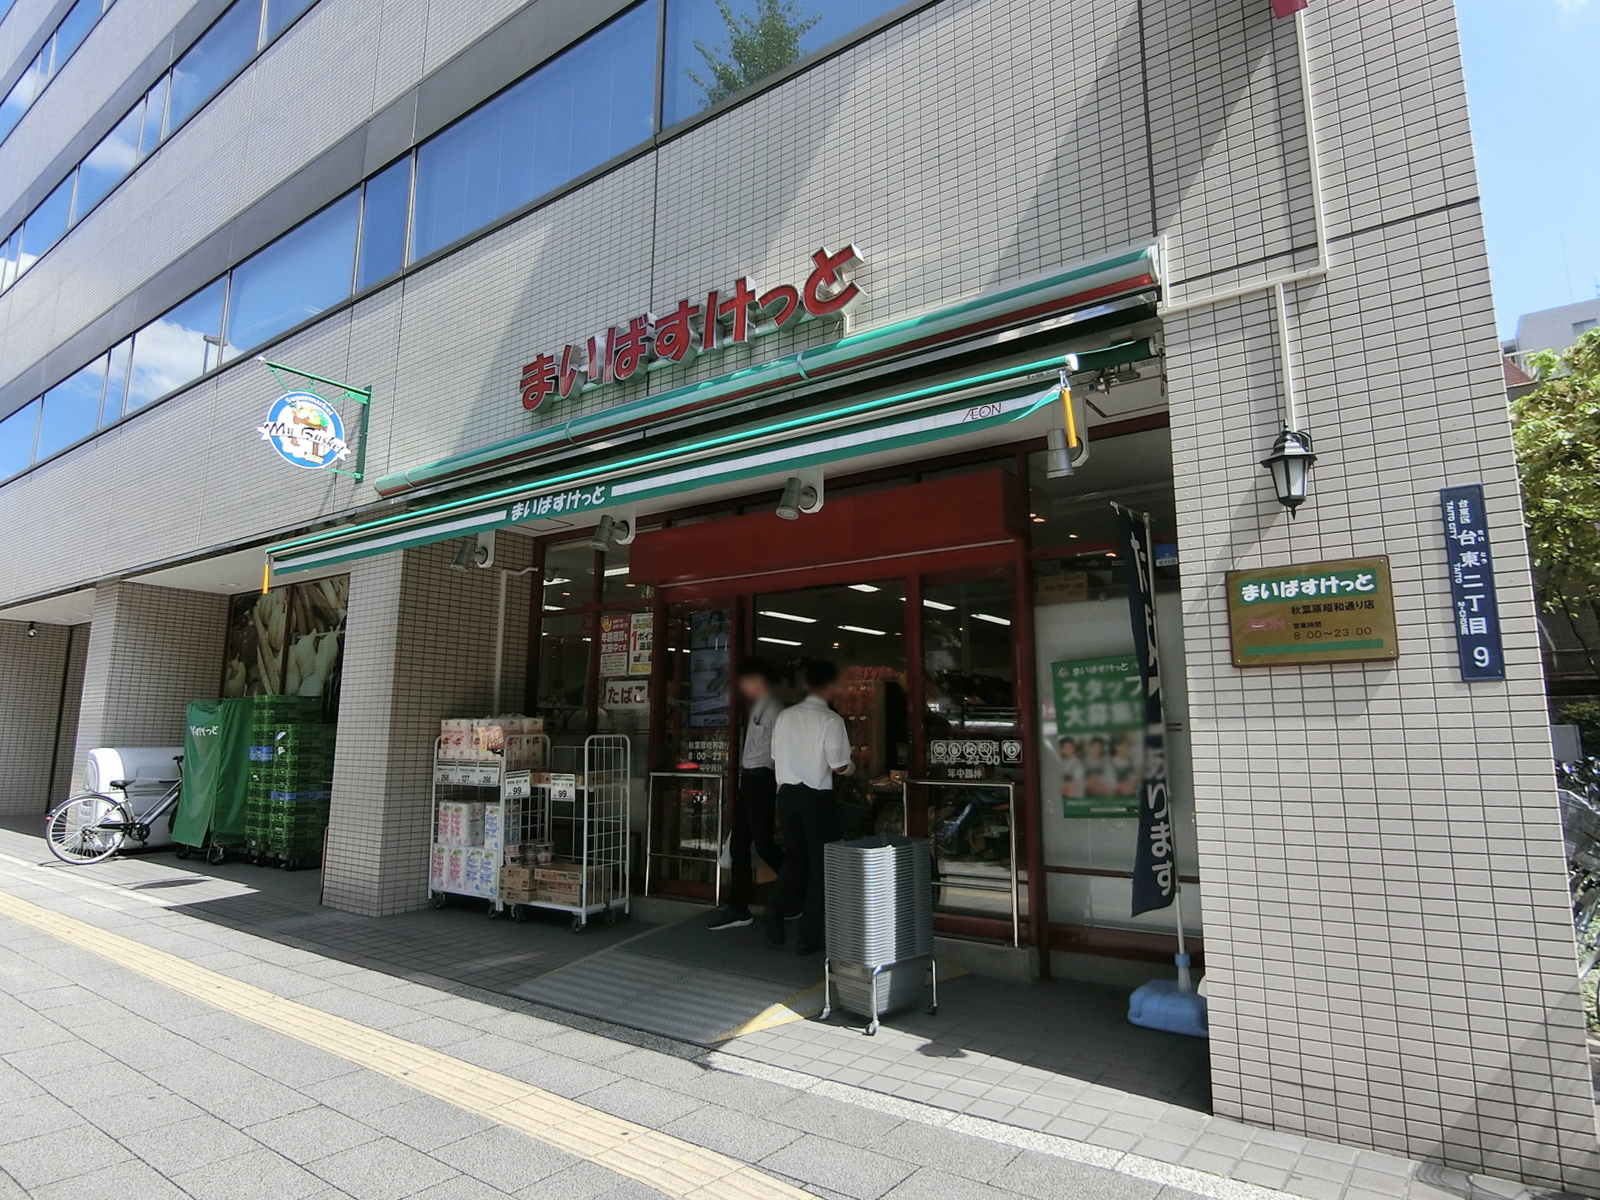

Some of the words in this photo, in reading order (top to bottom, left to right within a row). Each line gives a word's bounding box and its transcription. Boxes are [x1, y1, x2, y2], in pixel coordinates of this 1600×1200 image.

[519, 243, 868, 413] まいばすけっと
[263, 422, 294, 438] My
[511, 485, 606, 520] まいばすけっと
[1446, 500, 1456, 522] TAITO
[1448, 522, 1458, 540] CITY
[1453, 563, 1463, 584] TAITO
[1241, 573, 1375, 602] まいばすけっと
[1290, 599, 1375, 616] 秋葉原昭和通り店
[1457, 601, 1470, 636] 2-CHOME
[1473, 646, 1491, 668] 9
[607, 685, 646, 704] たばこ
[512, 786, 522, 795] 99
